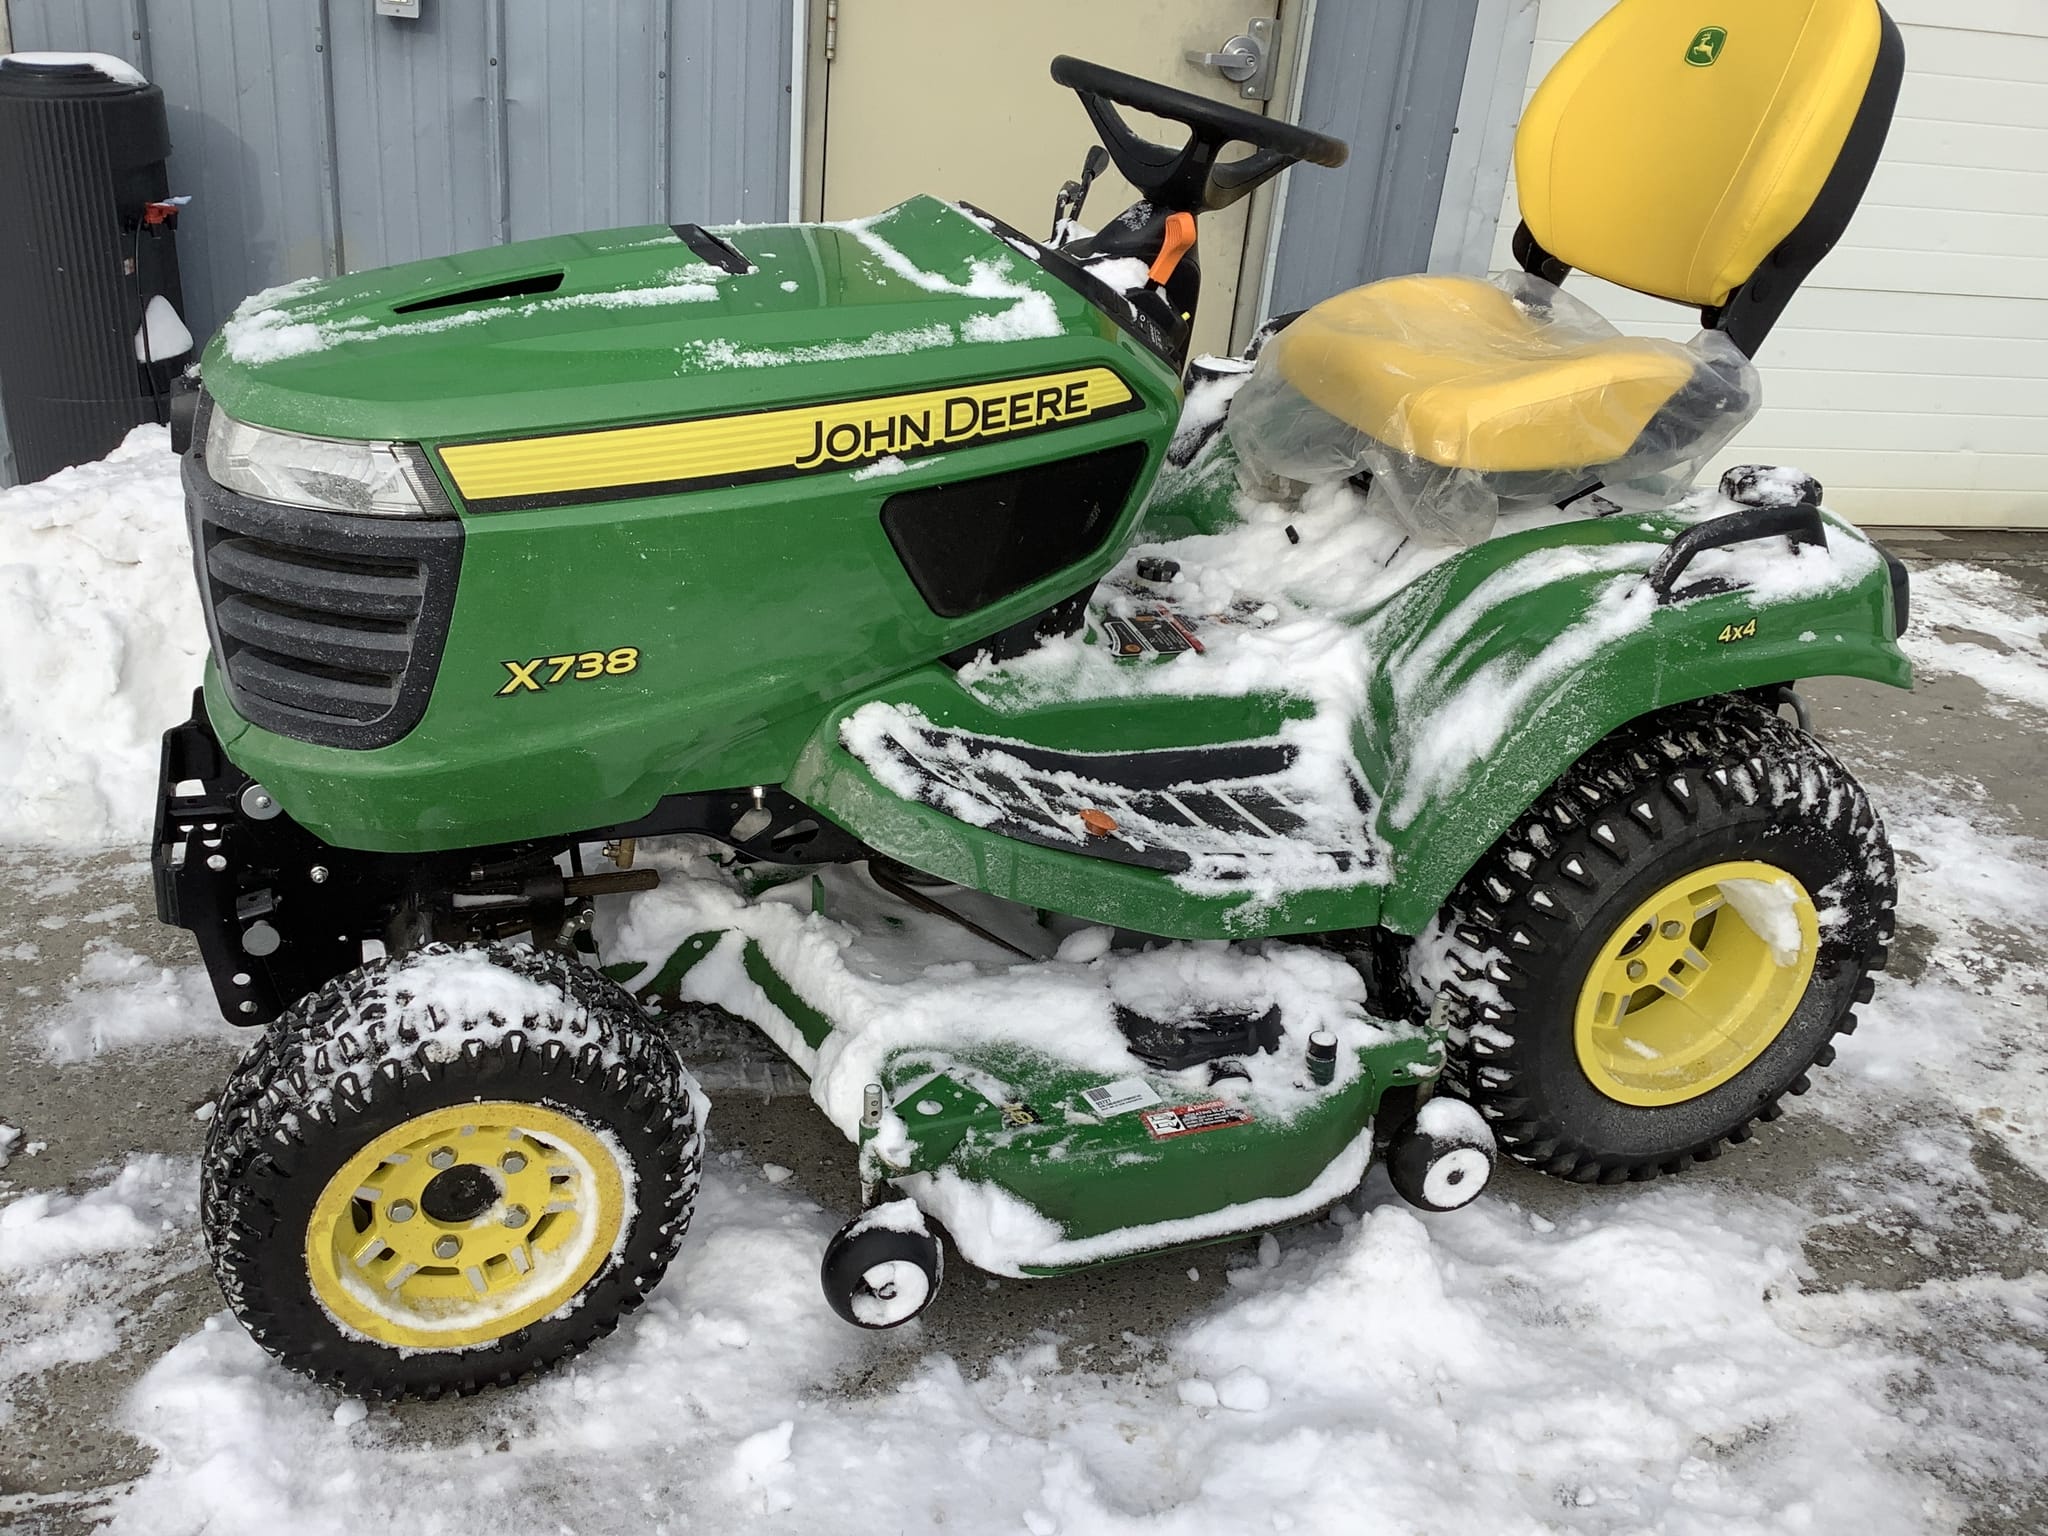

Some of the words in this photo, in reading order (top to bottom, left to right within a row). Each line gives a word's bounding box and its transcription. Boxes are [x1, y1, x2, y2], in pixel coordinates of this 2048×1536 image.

[795, 410, 931, 464] JOHN
[944, 380, 1089, 438] DEERE
[1718, 618, 1756, 642] 4x4
[496, 647, 639, 695] X738
